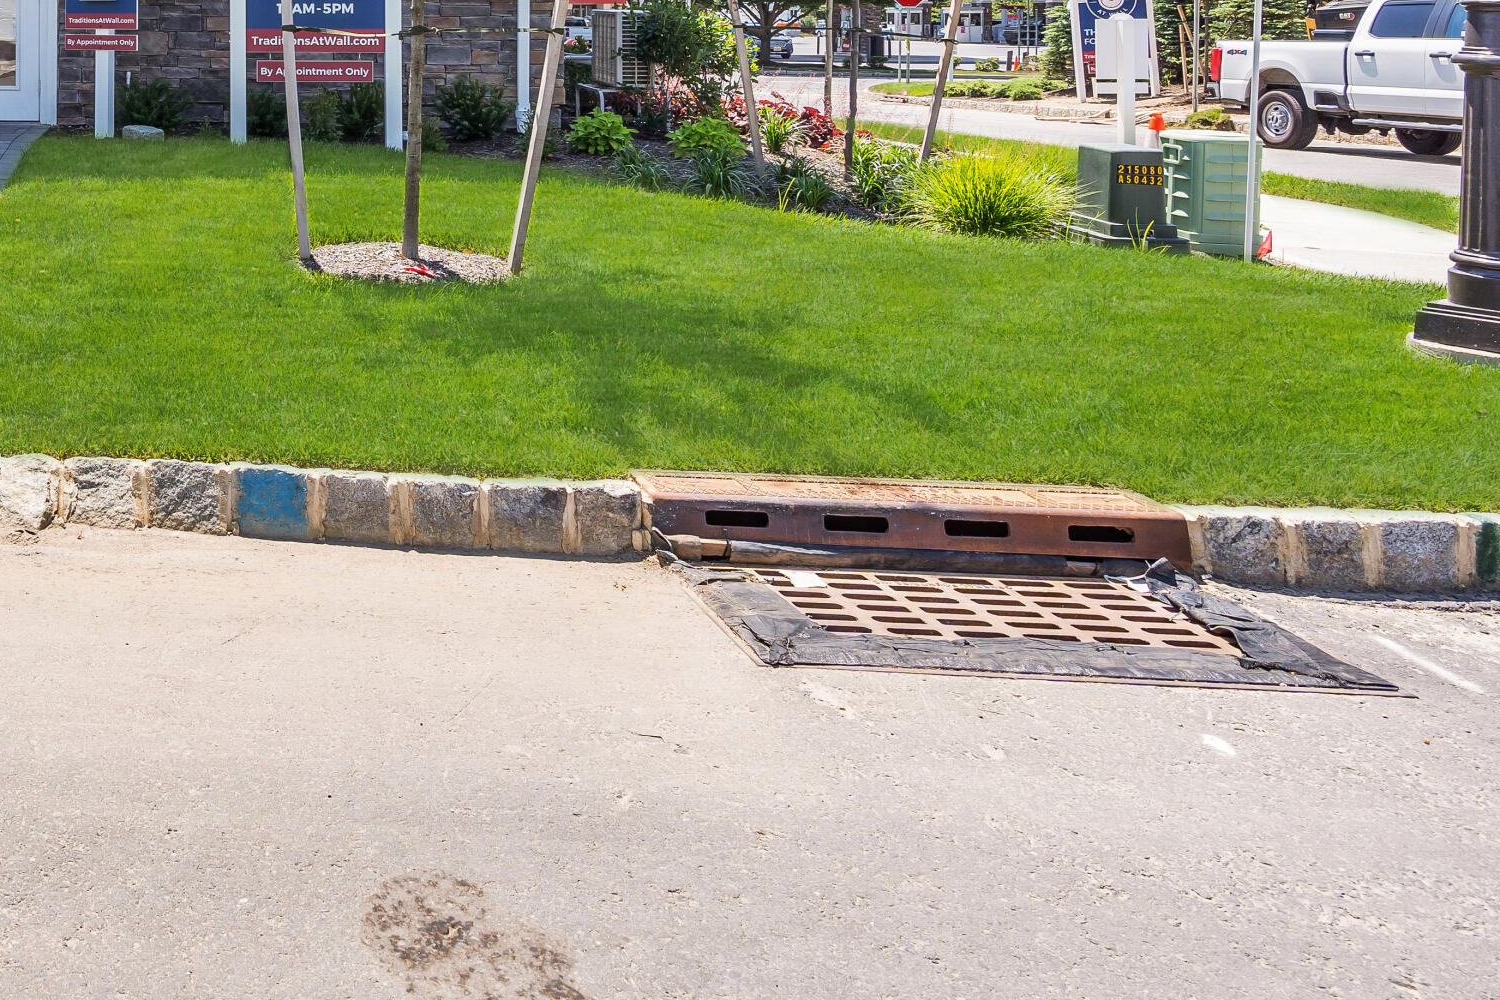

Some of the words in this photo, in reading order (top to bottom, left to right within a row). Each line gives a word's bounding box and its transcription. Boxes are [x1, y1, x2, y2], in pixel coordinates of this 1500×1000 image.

[67, 38, 76, 46] By
[76, 39, 118, 47] Appointment
[119, 39, 135, 47] Only
[260, 67, 273, 77] By
[275, 67, 343, 78] Aointment
[345, 67, 369, 77] Only
[1118, 164, 1163, 175] 215080
[1118, 174, 1163, 186] A50432
